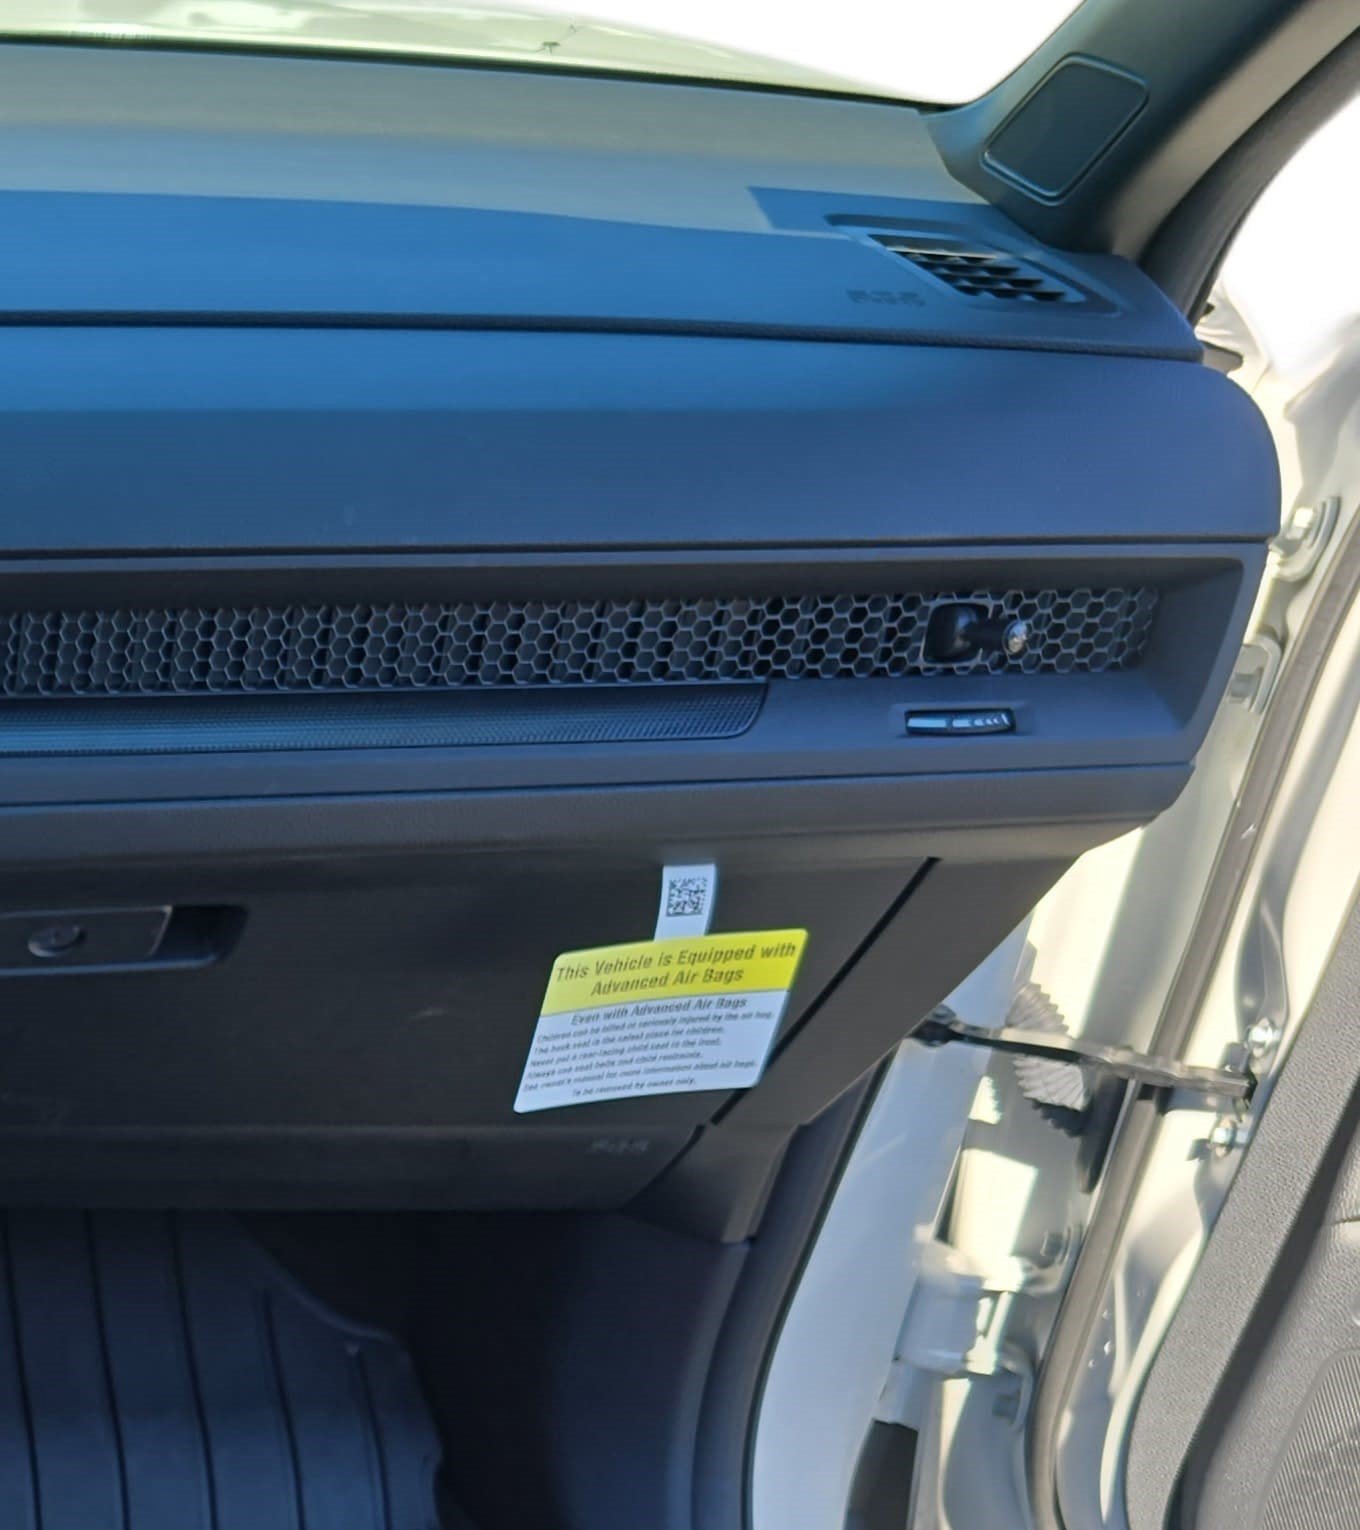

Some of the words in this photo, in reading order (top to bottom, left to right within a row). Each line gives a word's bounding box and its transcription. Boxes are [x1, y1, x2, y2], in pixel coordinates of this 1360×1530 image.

[556, 963, 590, 983] This
[594, 953, 653, 976] Vehicle
[658, 951, 673, 967] is
[676, 943, 757, 966] Equipped
[759, 942, 797, 959] with
[590, 971, 669, 997] Advanced
[672, 968, 698, 985] Air
[702, 967, 745, 985] Bags
[570, 1013, 600, 1026] Even
[602, 1007, 629, 1020] with
[631, 999, 690, 1017] Advanced
[693, 998, 712, 1010] Air
[715, 998, 748, 1011] Bags
